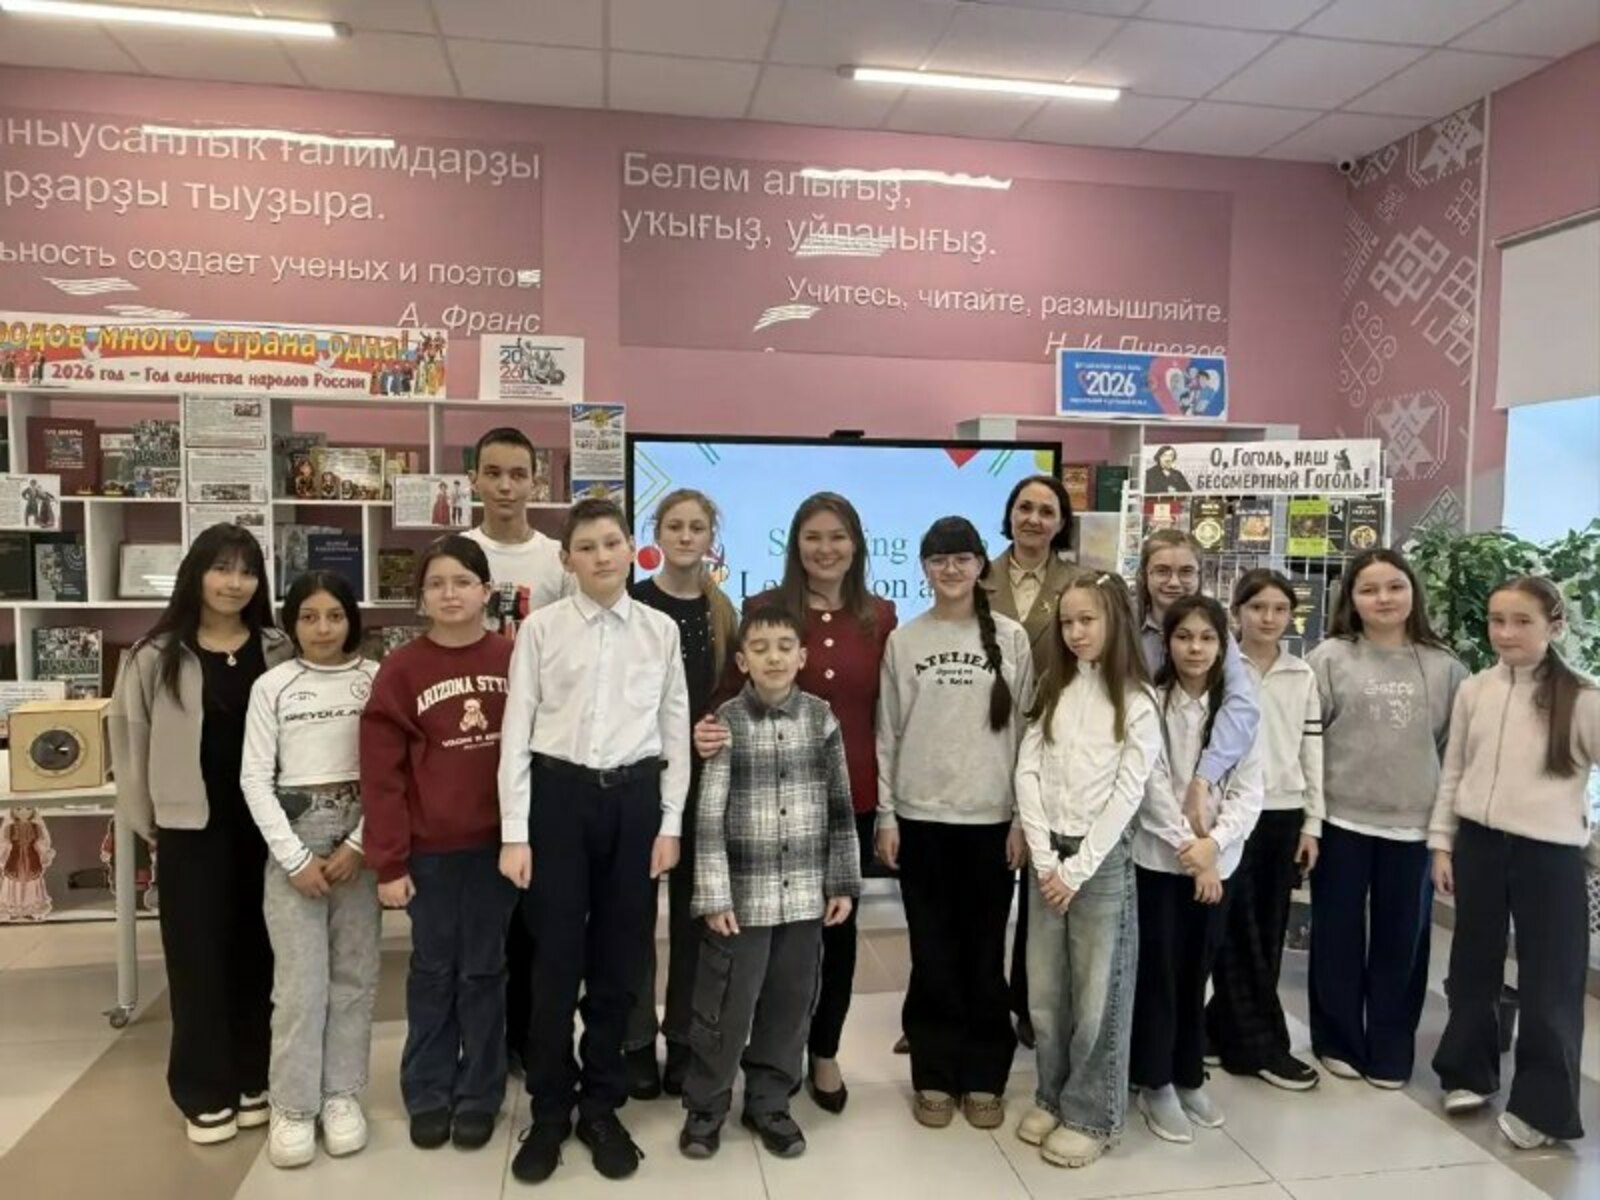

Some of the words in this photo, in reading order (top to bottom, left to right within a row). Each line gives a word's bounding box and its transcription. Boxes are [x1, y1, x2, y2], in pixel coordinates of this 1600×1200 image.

[623, 152, 749, 192] Белем
[127, 248, 262, 277] создает
[270, 255, 389, 282] ученых
[400, 262, 417, 282] и
[787, 276, 907, 310] Учитесь,
[918, 287, 1031, 317] читайте,
[1041, 294, 1228, 323] размышляйте.
[441, 304, 541, 336] Франс
[52, 363, 95, 381] 2026
[100, 371, 125, 382] год
[145, 367, 170, 382] Год
[175, 370, 243, 385] единства
[249, 372, 309, 390] народов
[314, 373, 365, 390] России
[1086, 371, 1137, 398] 2026
[416, 676, 475, 717] ARIZONA
